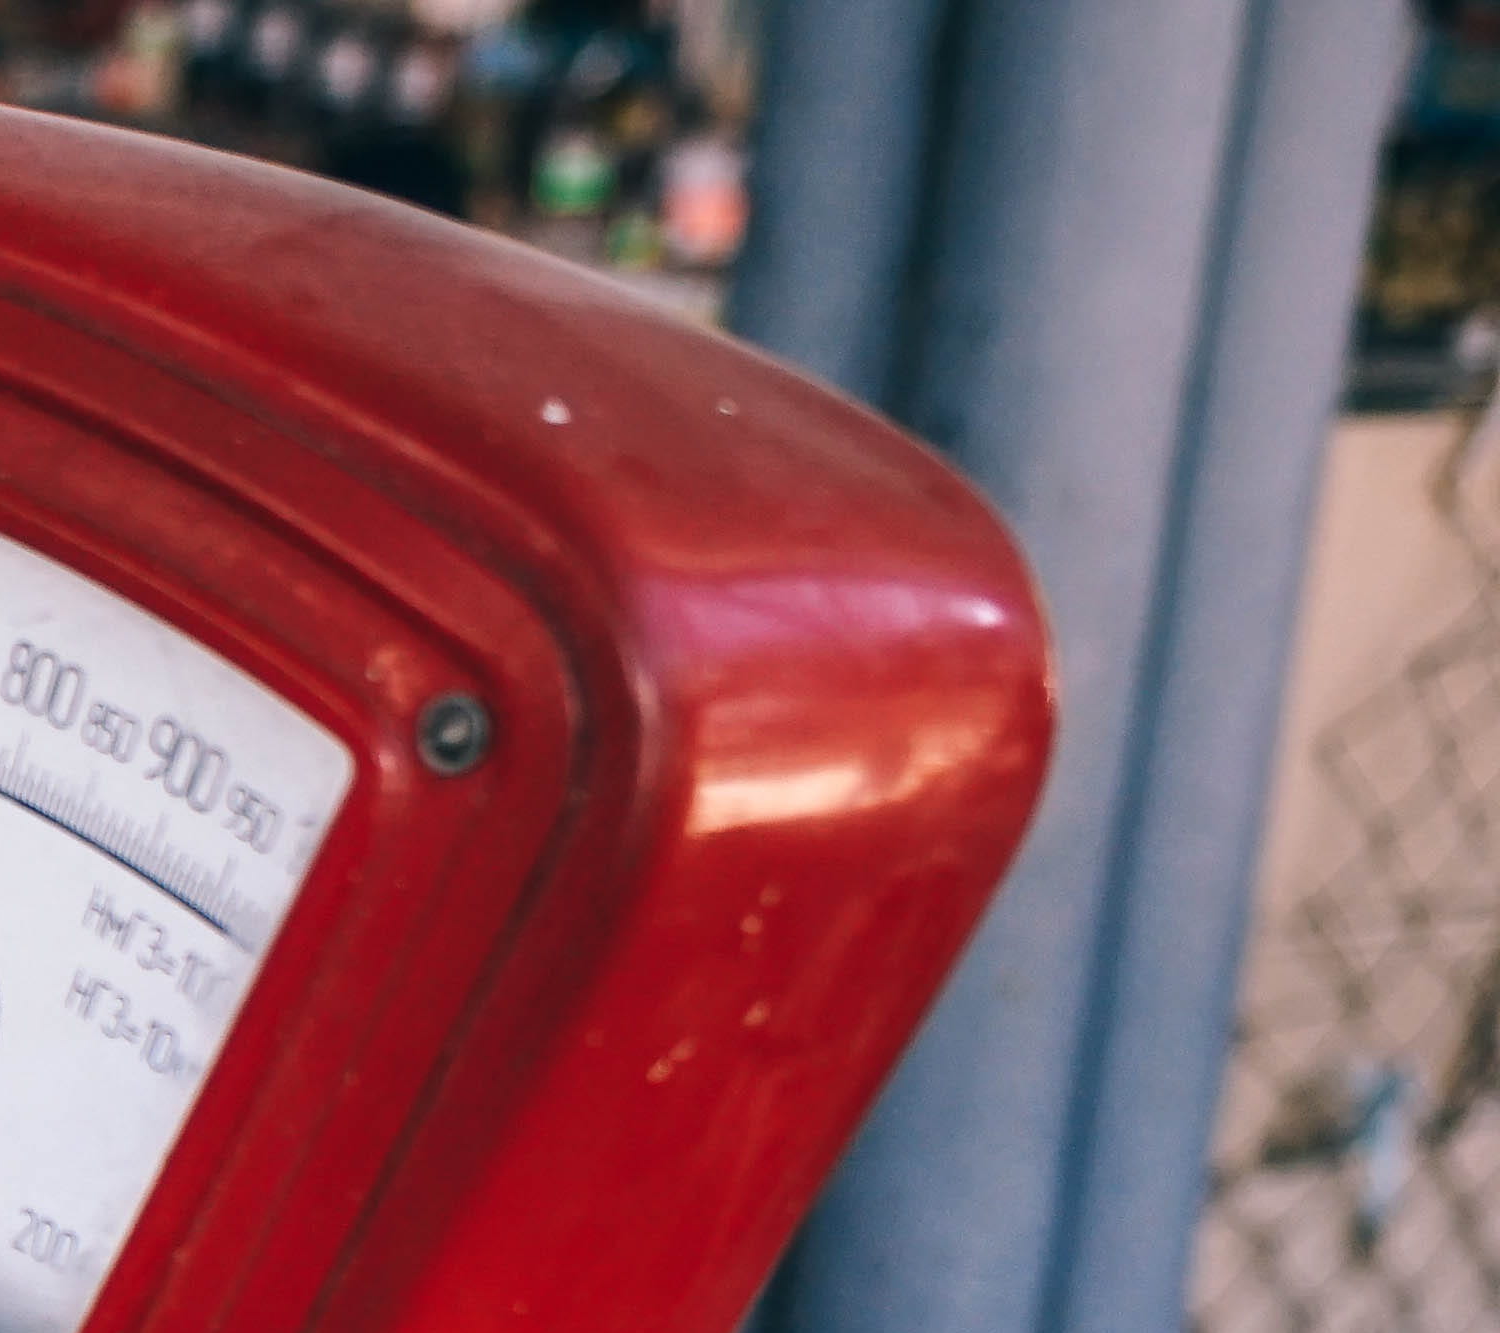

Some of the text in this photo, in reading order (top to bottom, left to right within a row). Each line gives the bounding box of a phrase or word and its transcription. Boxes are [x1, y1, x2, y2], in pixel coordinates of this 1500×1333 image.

[0, 637, 86, 731] 800
[80, 702, 143, 764] 850
[143, 713, 232, 816] 900
[219, 781, 286, 855] 950
